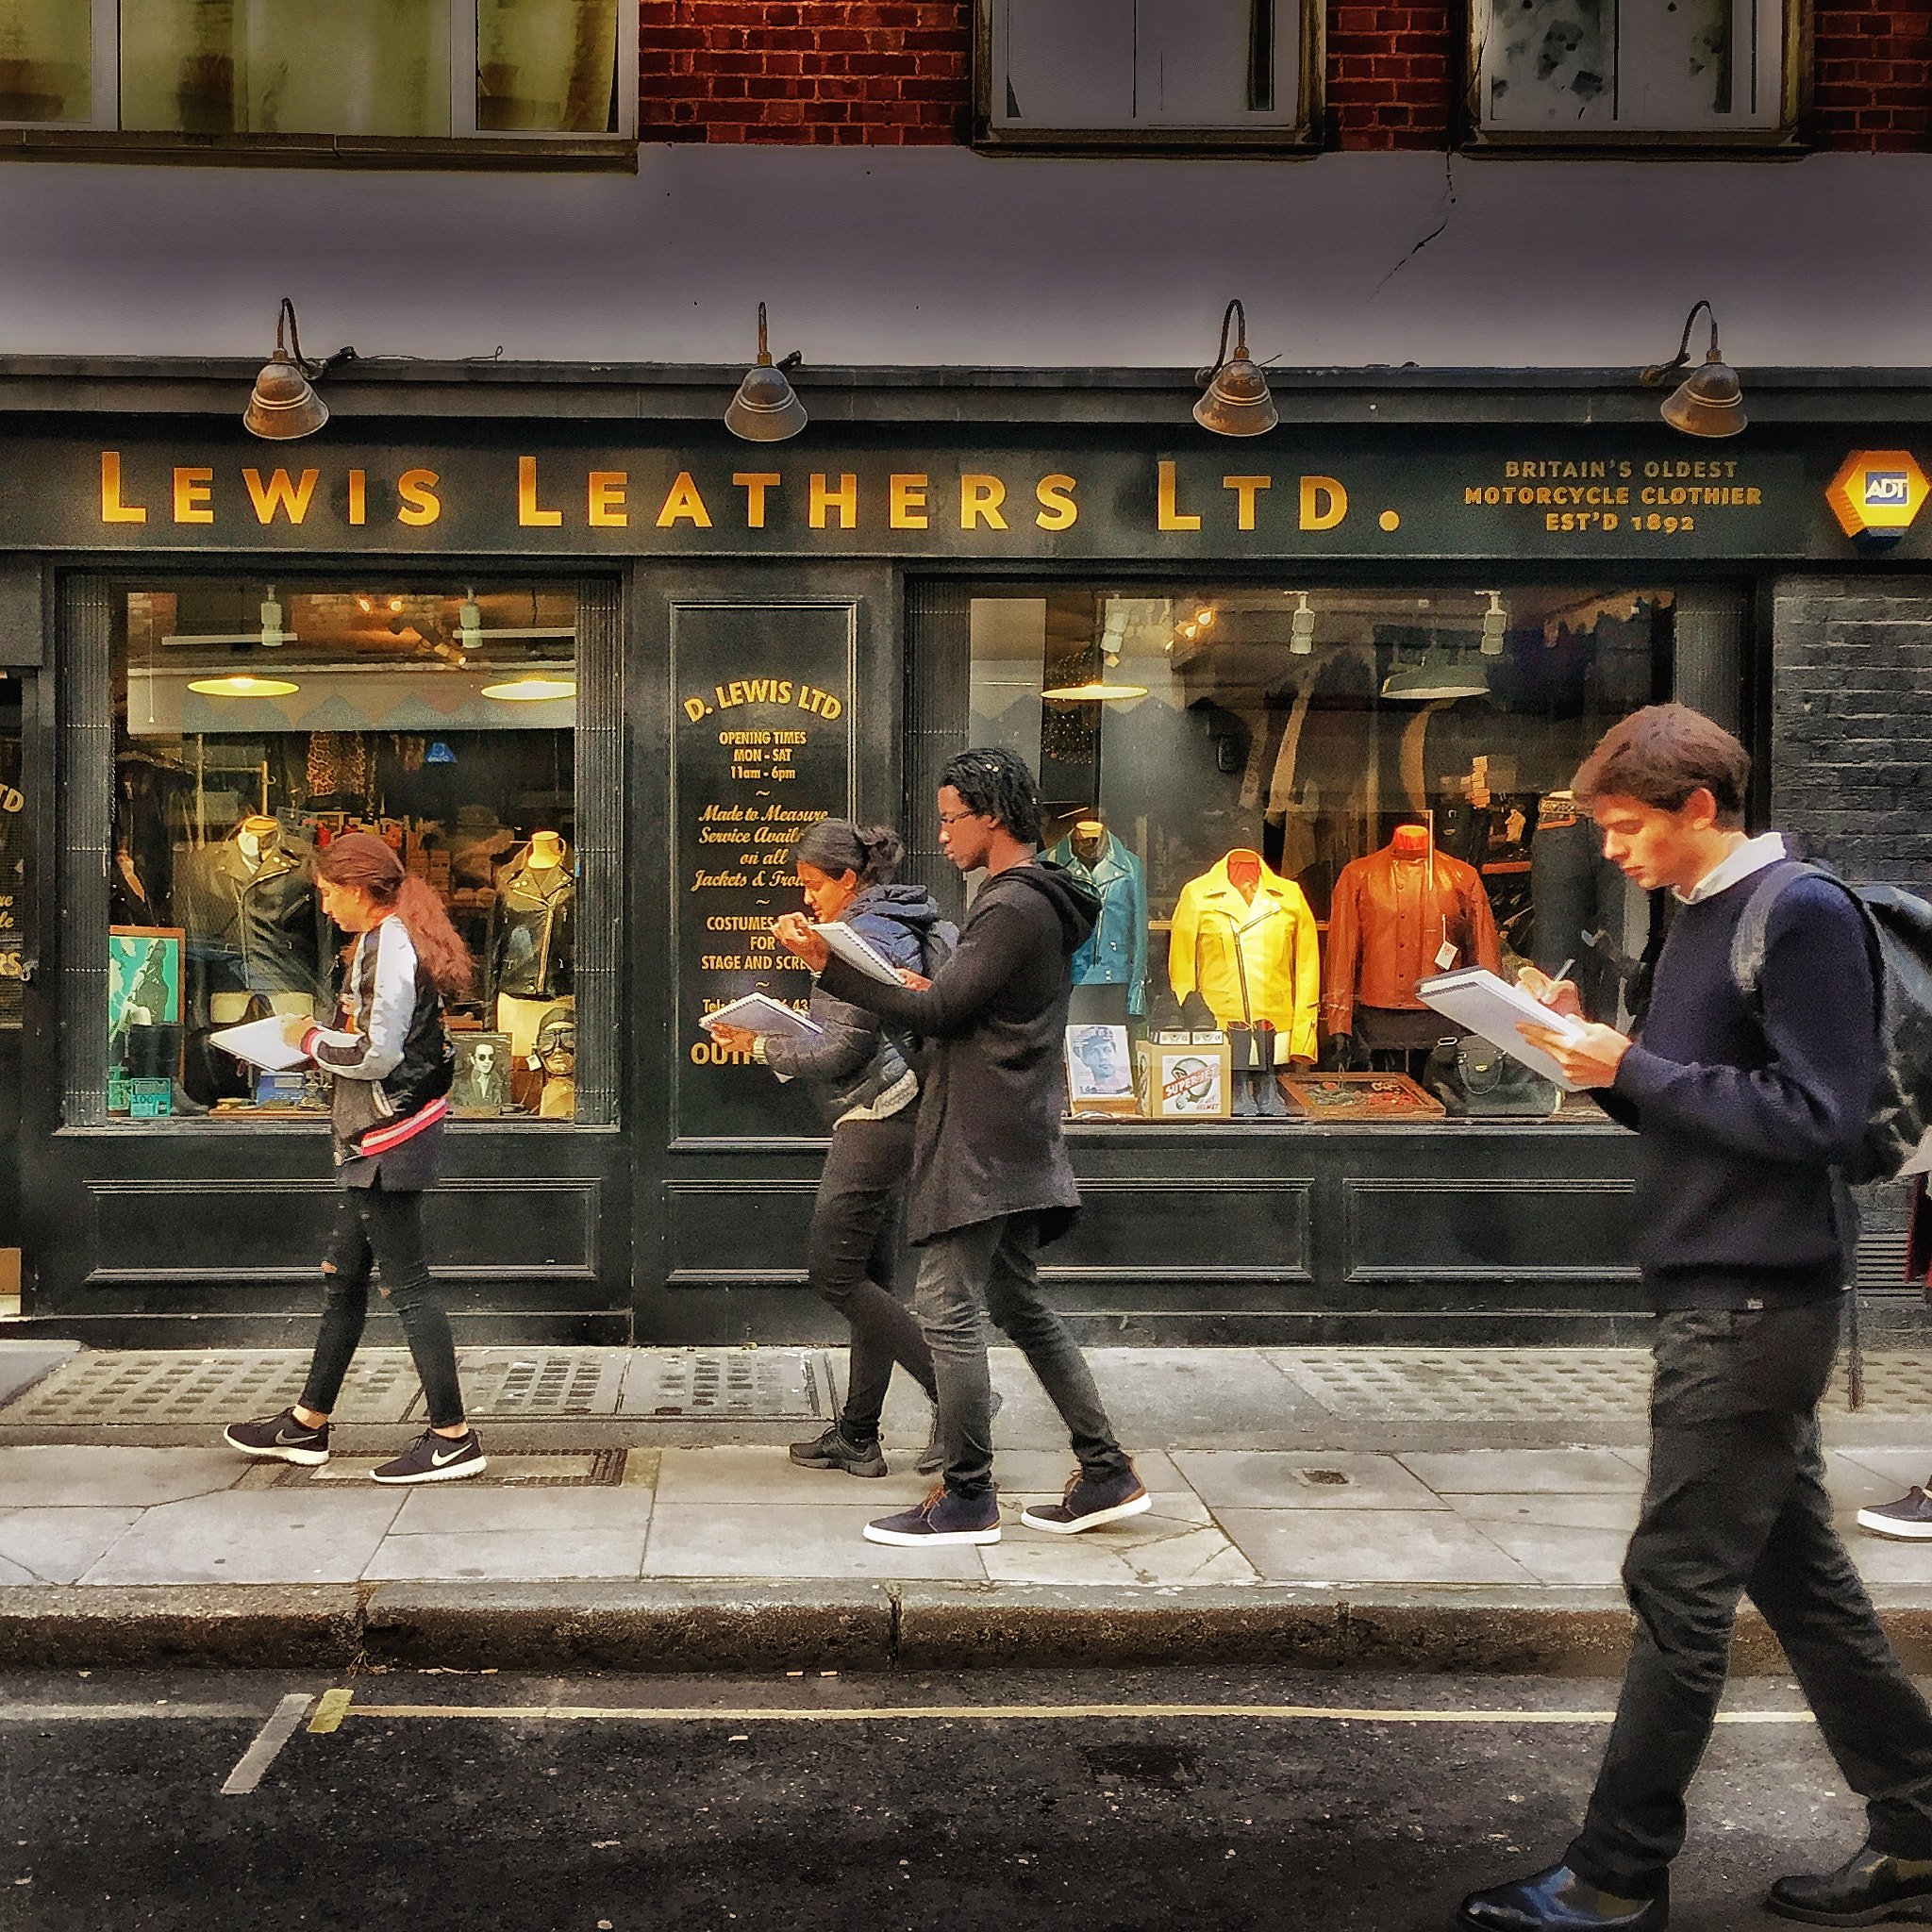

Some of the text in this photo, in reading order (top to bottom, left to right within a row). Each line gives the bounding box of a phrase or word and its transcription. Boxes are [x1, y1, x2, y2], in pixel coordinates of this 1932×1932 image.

[1505, 459, 1738, 478] BRITAIN'S OLDEST
[101, 451, 1400, 532] LEWIS LEATHERS LTD.
[1464, 487, 1762, 506] MOTORCYCLE CLOTHIER
[1865, 478, 1908, 499] ADT
[1545, 511, 1695, 534] EST'D 1892
[684, 679, 843, 723] D. LEWIS LTD
[719, 731, 808, 745] OPENING TIMES
[733, 749, 762, 762] MON
[772, 748, 793, 762] SAT
[731, 765, 761, 779] 11am
[771, 766, 796, 782] 6pm
[698, 804, 829, 822] Made to Measure
[698, 825, 751, 844] Service
[740, 848, 790, 865] on all
[690, 869, 747, 892] Jackets
[752, 870, 767, 887] &
[707, 916, 774, 931] COSTUMES
[750, 936, 776, 951] FOR
[701, 955, 741, 970] STAGE
[743, 955, 773, 970] AND
